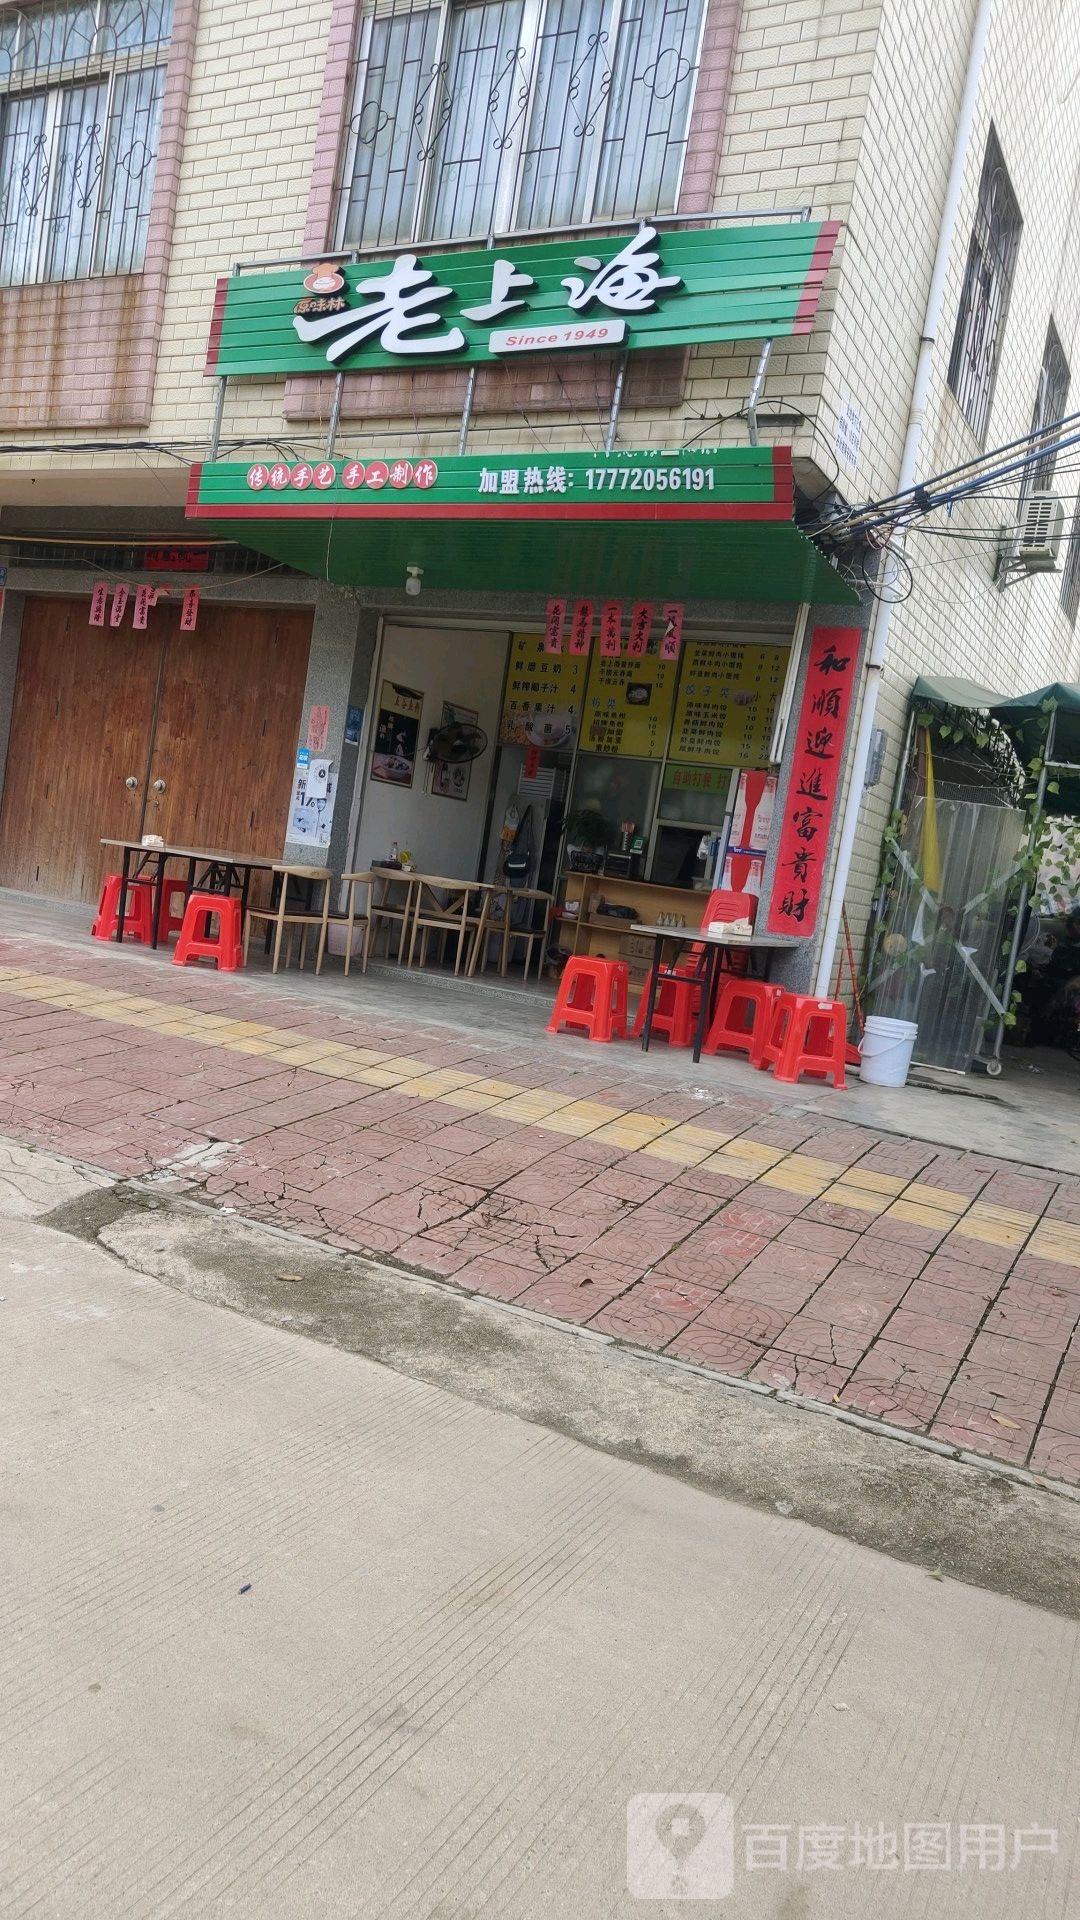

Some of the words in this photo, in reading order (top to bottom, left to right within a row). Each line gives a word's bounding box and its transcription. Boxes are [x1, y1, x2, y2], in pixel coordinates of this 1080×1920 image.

[292, 226, 681, 362] 老上海
[506, 334, 558, 346] Since
[564, 328, 609, 341] 1949
[248, 465, 335, 488] 传统手艺
[344, 461, 437, 487] 手工制作
[586, 468, 715, 491] 17772056191
[633, 608, 648, 654] 大吉大利
[572, 665, 578, 675] 3
[570, 685, 576, 694] 4
[769, 691, 777, 704] 大
[510, 701, 555, 713] 百香果汁
[568, 705, 574, 714] 4
[507, 720, 552, 734] 乳酸菌
[565, 725, 571, 734] 5
[778, 646, 850, 922] 和順迎進富貴財
